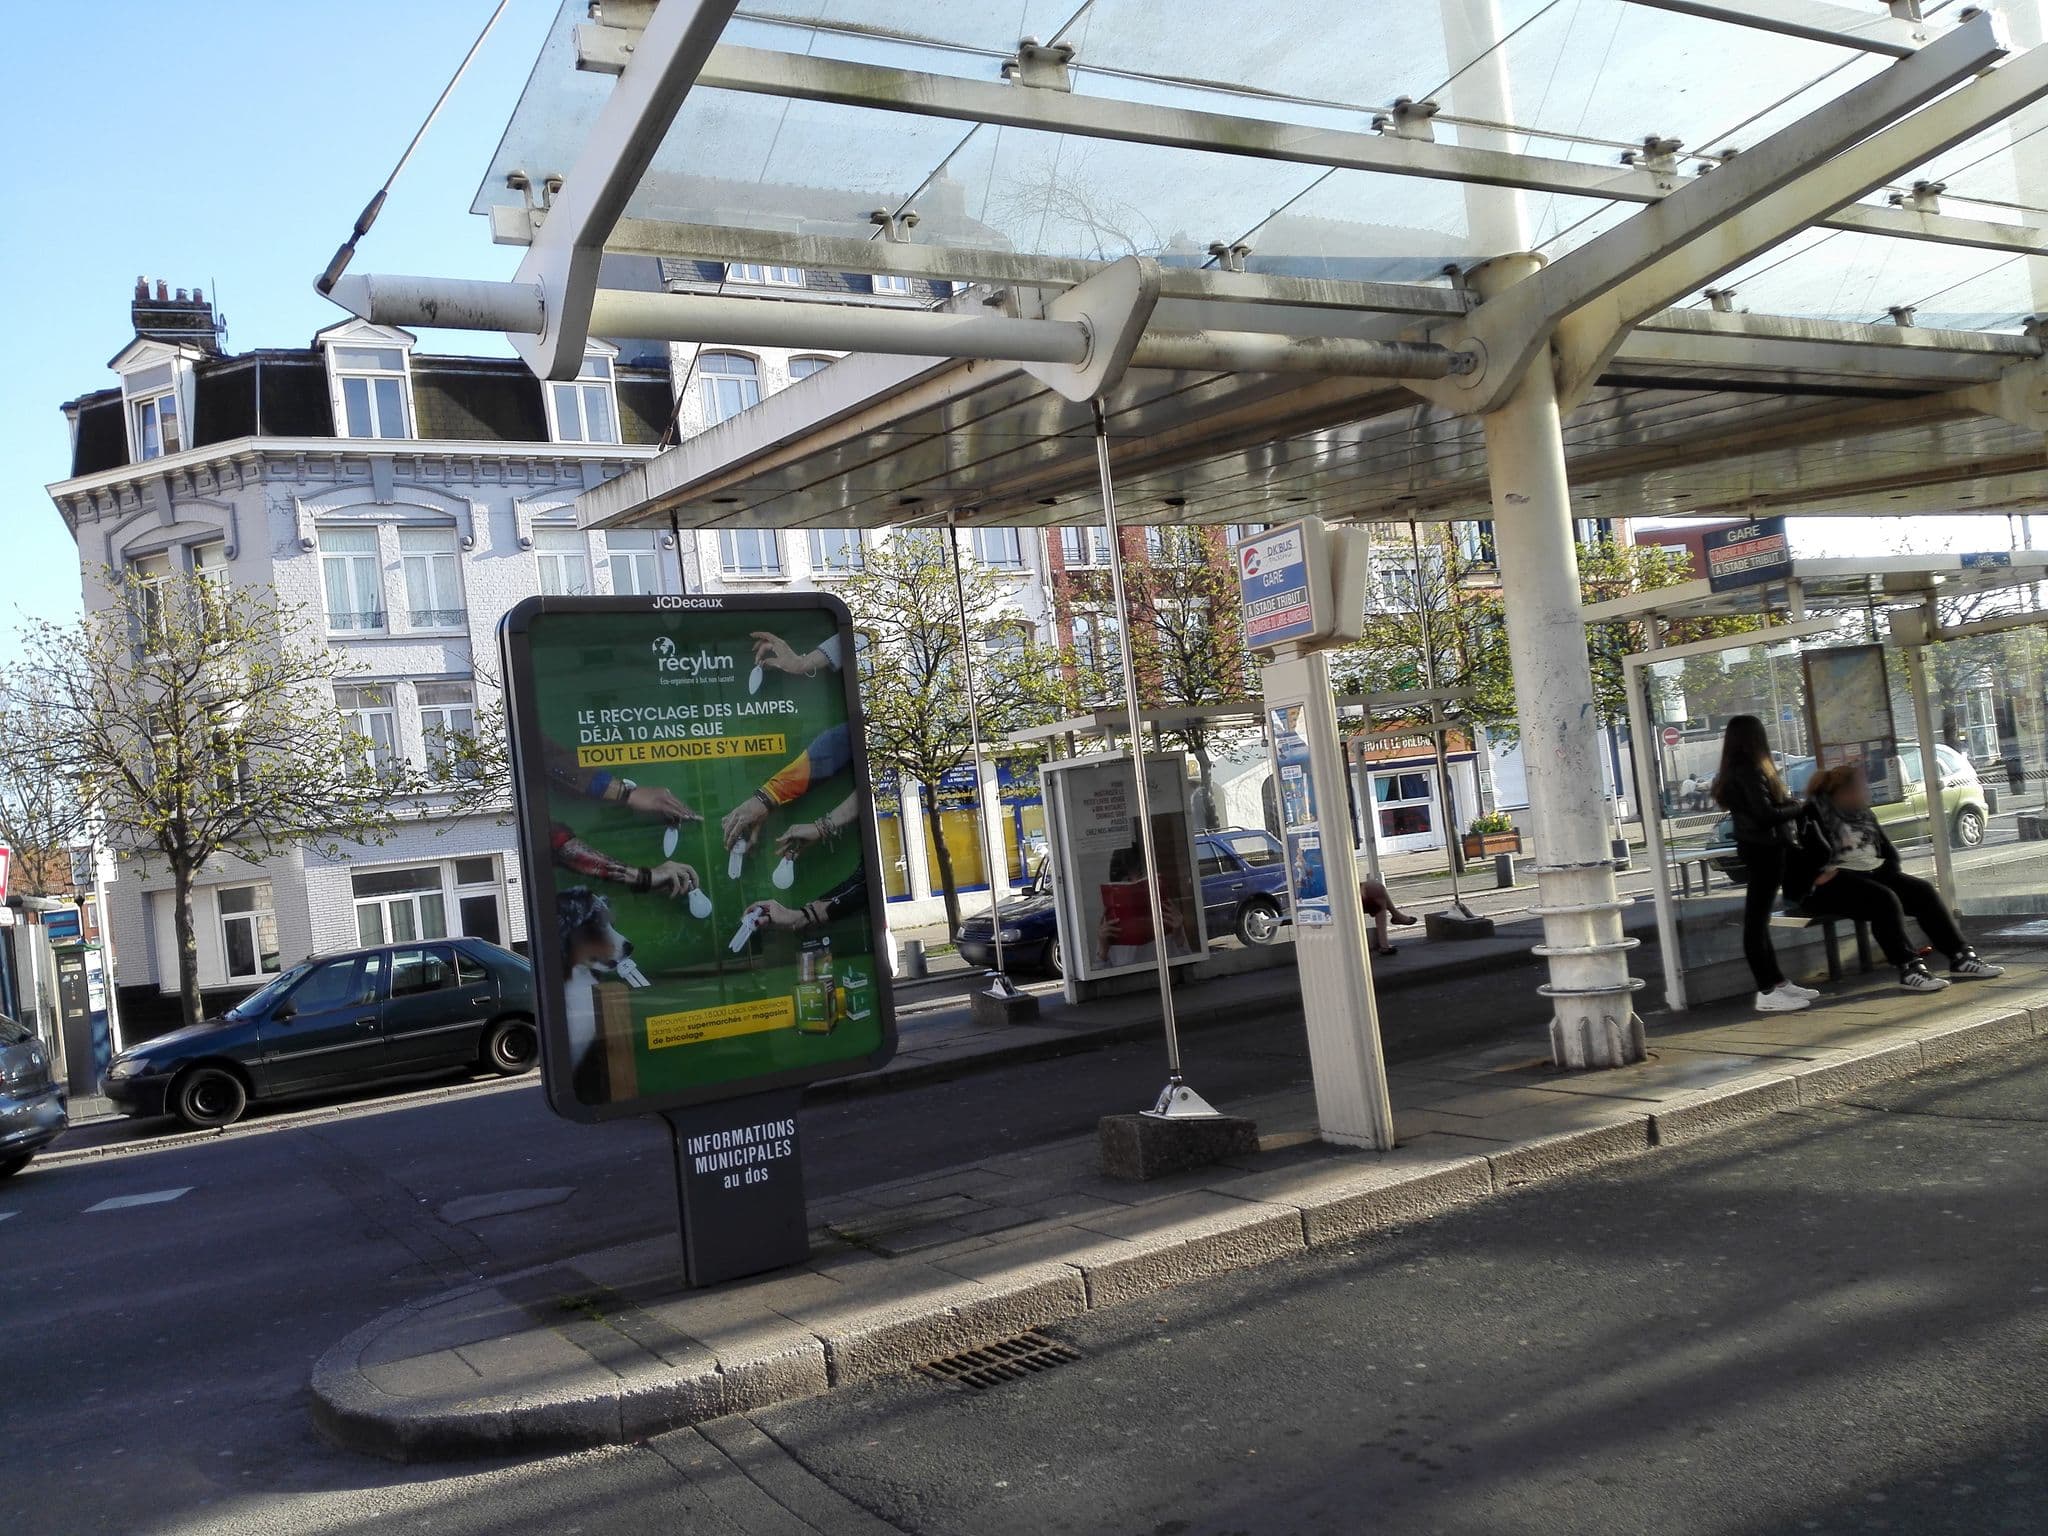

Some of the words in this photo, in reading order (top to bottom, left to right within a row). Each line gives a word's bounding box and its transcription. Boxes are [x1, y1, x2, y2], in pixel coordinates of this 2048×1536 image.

[1727, 524, 1760, 542] GARE
[1724, 559, 1750, 572] STADE
[1750, 552, 1779, 567] TRIBUT
[1262, 570, 1284, 587] GARE
[652, 596, 723, 609] JCDecaux
[1255, 599, 1276, 615] STADE
[1276, 590, 1300, 609] TRIBUT
[578, 710, 596, 725] LE
[600, 705, 699, 723] RECYCLAGE
[703, 703, 732, 718] DES
[737, 700, 798, 716] LAMPES,
[580, 724, 623, 744] DÉJÀ
[628, 726, 648, 741] 10
[653, 723, 686, 739] ANS
[690, 722, 723, 736] QUE
[581, 748, 624, 763] TOUT
[629, 746, 646, 760] LE
[651, 742, 712, 759] MONDE
[716, 740, 739, 755] S'Y
[745, 738, 774, 752] MET
[687, 1015, 742, 1031] supermarchés
[752, 1008, 789, 1021] magasins
[652, 1036, 664, 1045] de
[665, 1030, 705, 1044] bricolage
[687, 1118, 795, 1155] INFORMATIONS
[695, 1139, 792, 1174] MUNICIPALES
[723, 1173, 740, 1188] au
[745, 1167, 769, 1184] dos
